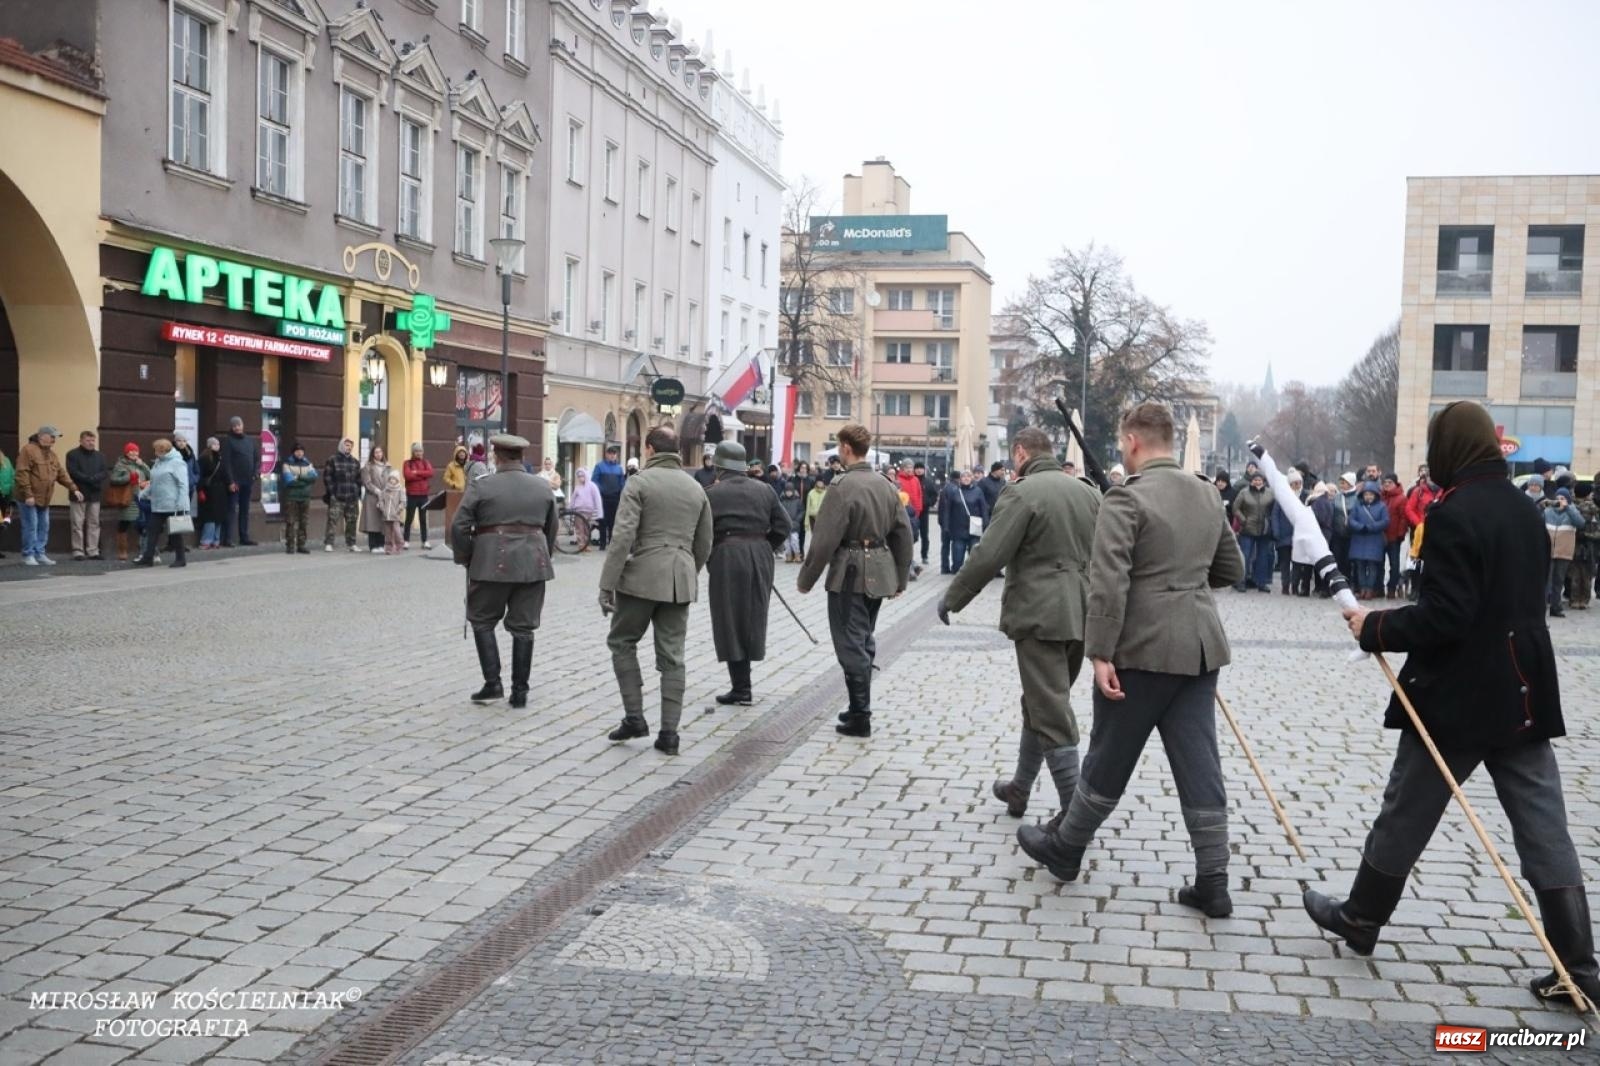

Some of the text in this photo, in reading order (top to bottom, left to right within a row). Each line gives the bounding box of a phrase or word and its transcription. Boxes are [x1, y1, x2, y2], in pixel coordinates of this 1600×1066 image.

[843, 228, 912, 239] McDonald's
[141, 246, 345, 330] APTEKA
[171, 325, 204, 341] RYNEK
[205, 331, 217, 344] 12
[223, 333, 264, 350] CENTRUM
[263, 339, 331, 360] FARMACEUTYCZNE
[285, 324, 344, 343] POD RÓŻAMI
